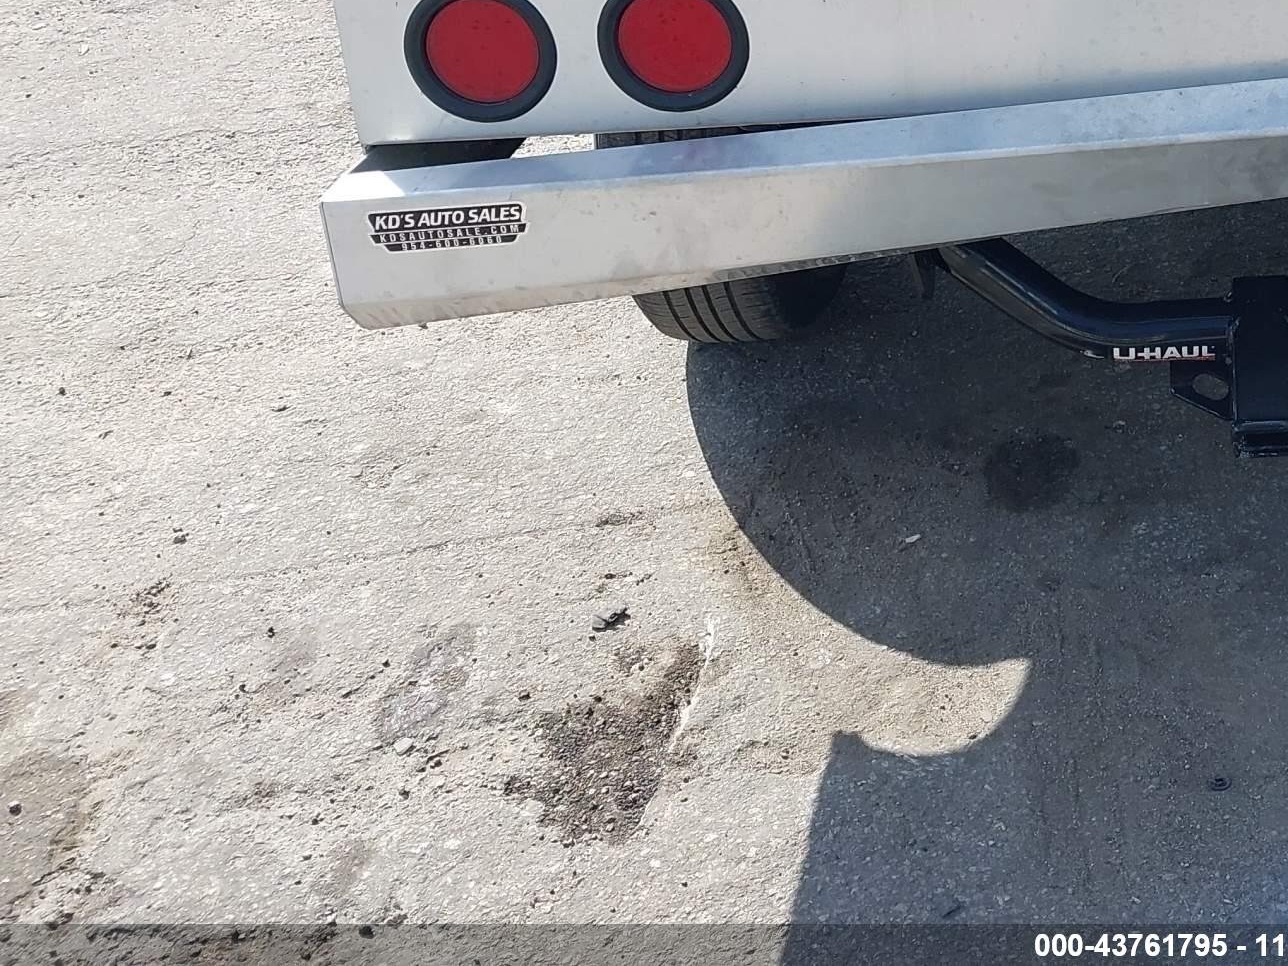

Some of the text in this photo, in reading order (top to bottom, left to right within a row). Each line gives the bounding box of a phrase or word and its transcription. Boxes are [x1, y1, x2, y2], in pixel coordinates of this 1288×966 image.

[375, 206, 520, 230] KD'S AUTO SALES
[380, 224, 519, 243] KDSAUTOSALE.COM
[1113, 345, 1216, 360] U-HAUL
